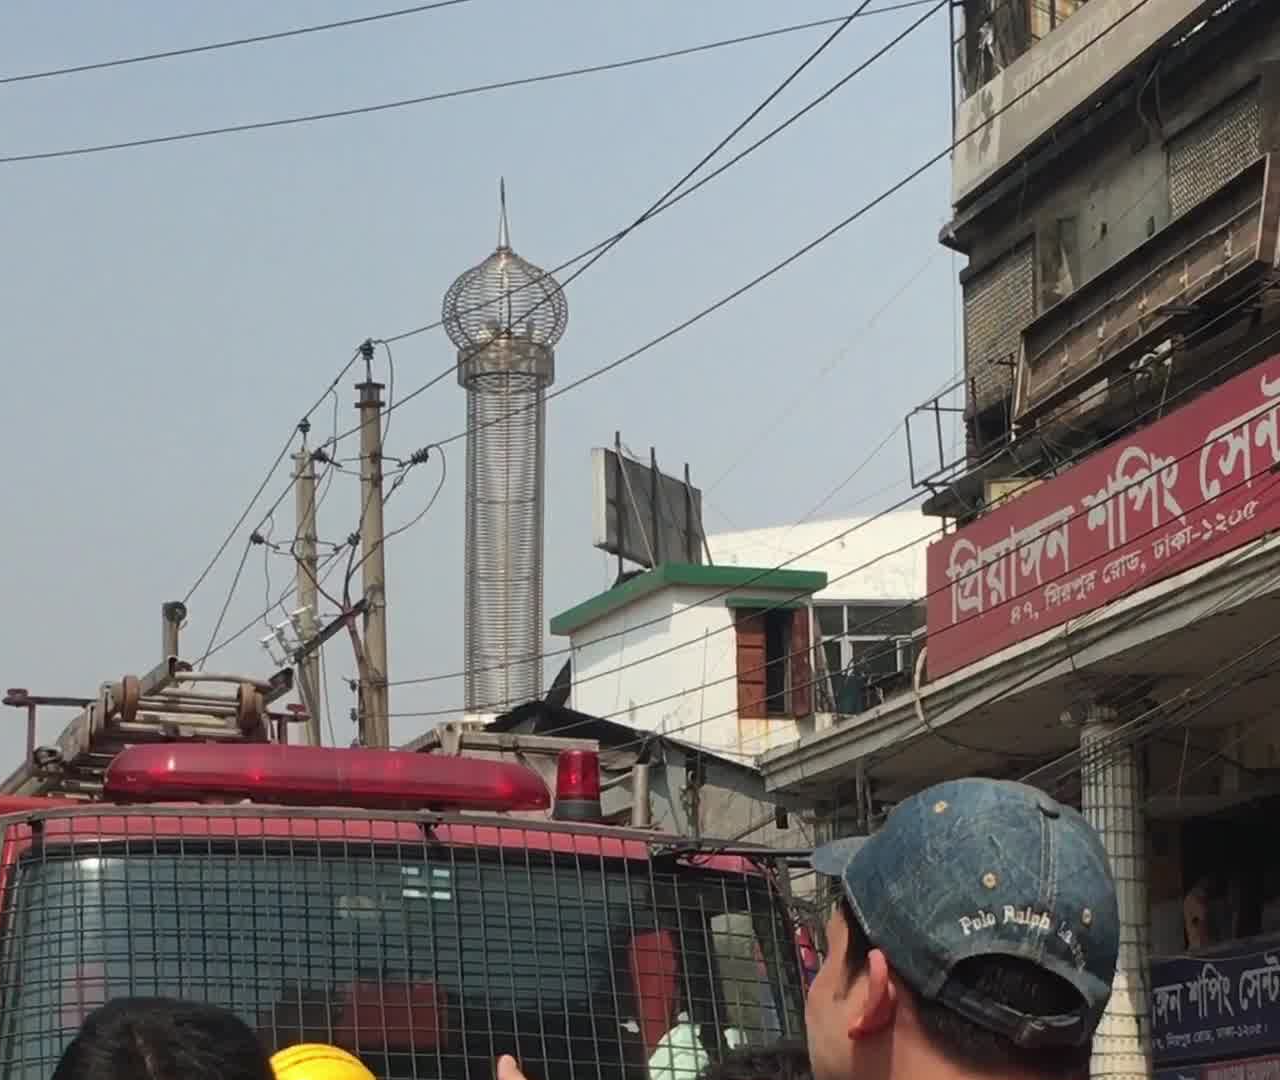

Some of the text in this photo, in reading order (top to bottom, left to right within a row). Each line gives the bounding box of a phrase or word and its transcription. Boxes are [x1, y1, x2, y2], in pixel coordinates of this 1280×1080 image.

[1081, 446, 1187, 551] শপিং
[958, 909, 995, 935] Polo
[1003, 904, 1051, 930] Ralph
[1186, 962, 1235, 1018] শপিং
